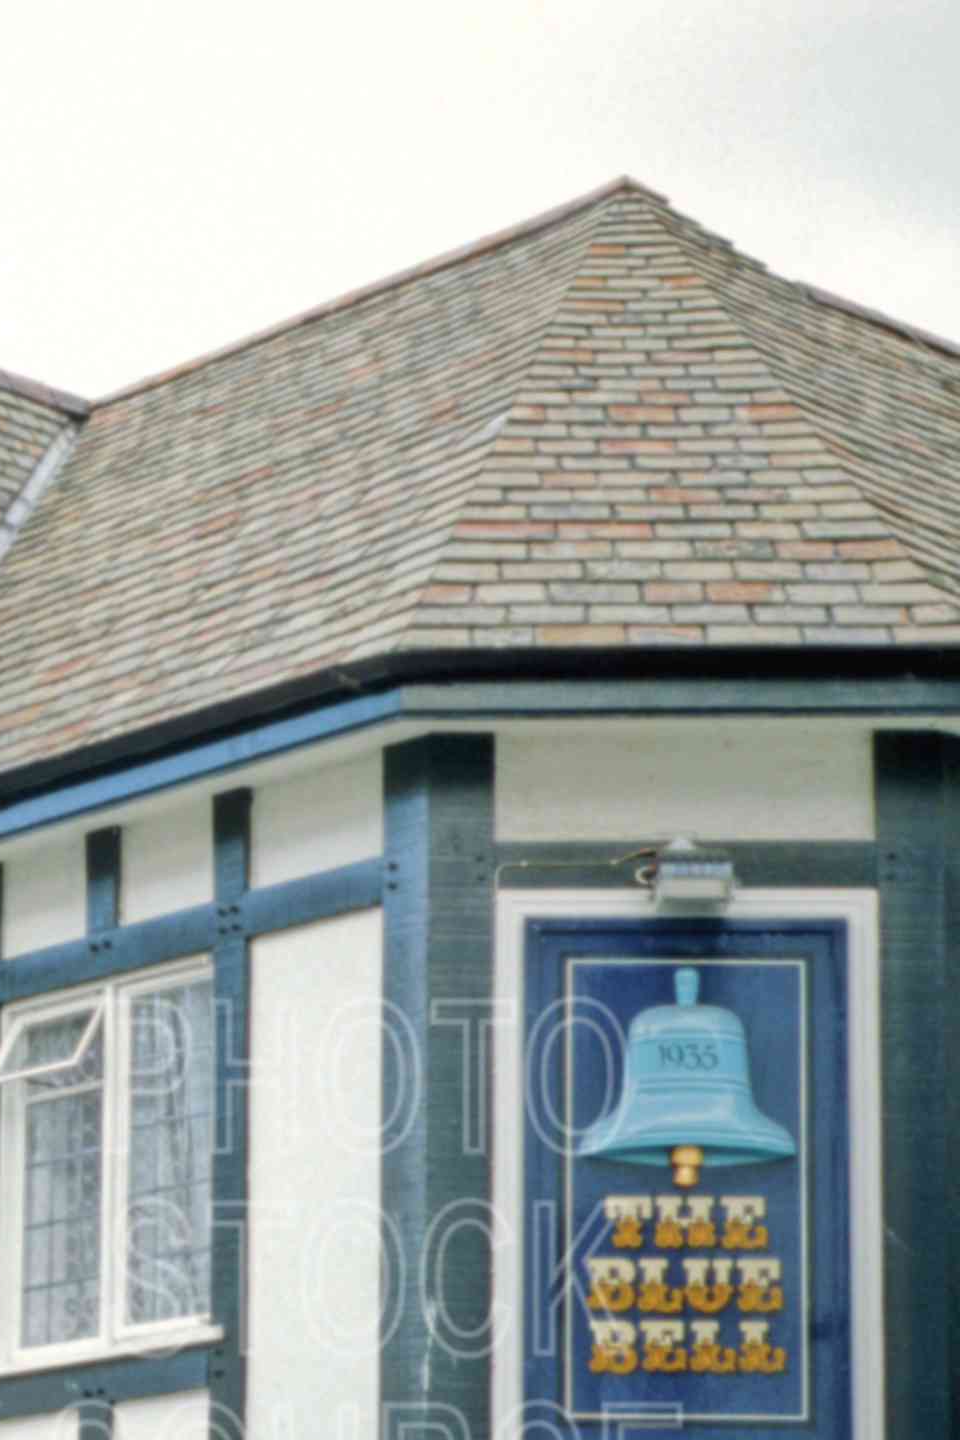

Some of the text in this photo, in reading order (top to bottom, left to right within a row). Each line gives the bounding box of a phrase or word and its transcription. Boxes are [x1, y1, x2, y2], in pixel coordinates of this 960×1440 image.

[658, 1043, 719, 1070] 1935
[604, 1195, 768, 1249] THE
[586, 1256, 784, 1313] BLUE
[588, 1319, 787, 1374] BELL
